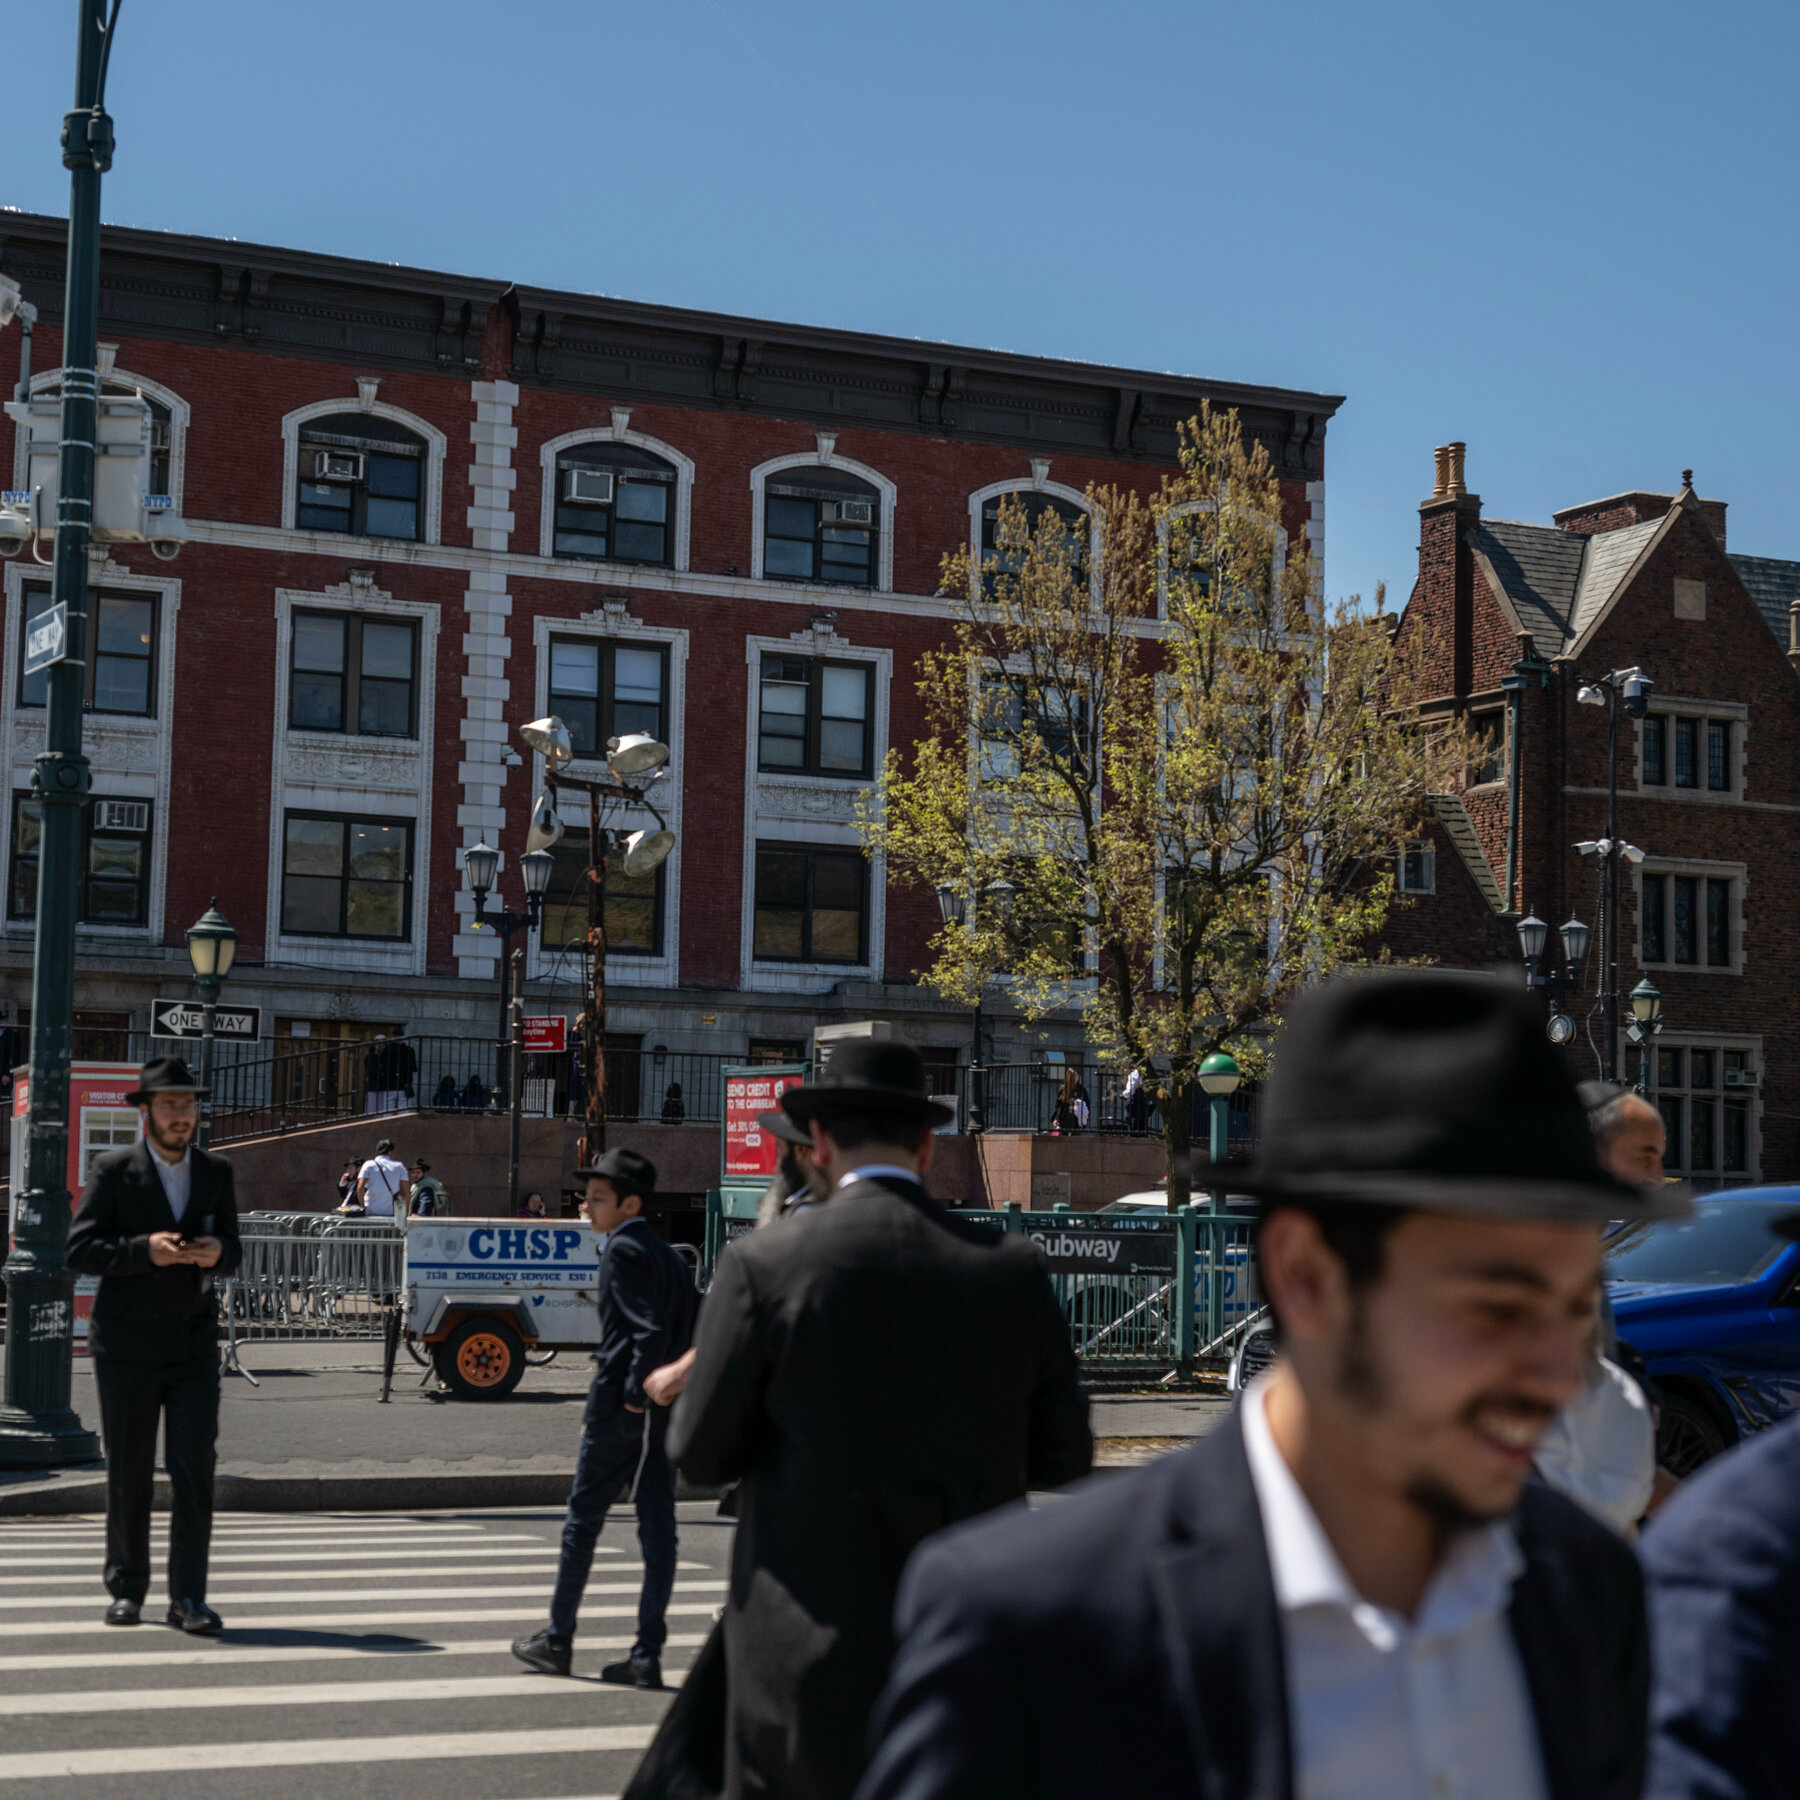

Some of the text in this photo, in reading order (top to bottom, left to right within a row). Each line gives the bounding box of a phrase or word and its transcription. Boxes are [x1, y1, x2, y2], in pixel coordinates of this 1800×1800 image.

[4, 491, 30, 503] NYPD
[144, 495, 173, 508] NYPD
[29, 622, 60, 655] ONE WAY
[169, 1012, 246, 1031] ONE WAY
[531, 1019, 559, 1028] STANDING
[88, 1091, 116, 1100] VISITOR
[727, 1082, 771, 1098] SEND CREDIT
[727, 1098, 777, 1110] TO THE CARIBBEAN
[727, 1121, 737, 1133] Get
[749, 1120, 761, 1133] OFF
[469, 1228, 582, 1261] CHSP
[1029, 1232, 1122, 1263] Subway
[455, 1271, 518, 1282] EMERGENCY
[520, 1271, 562, 1282] SERVICE
[568, 1273, 587, 1282] ESU
